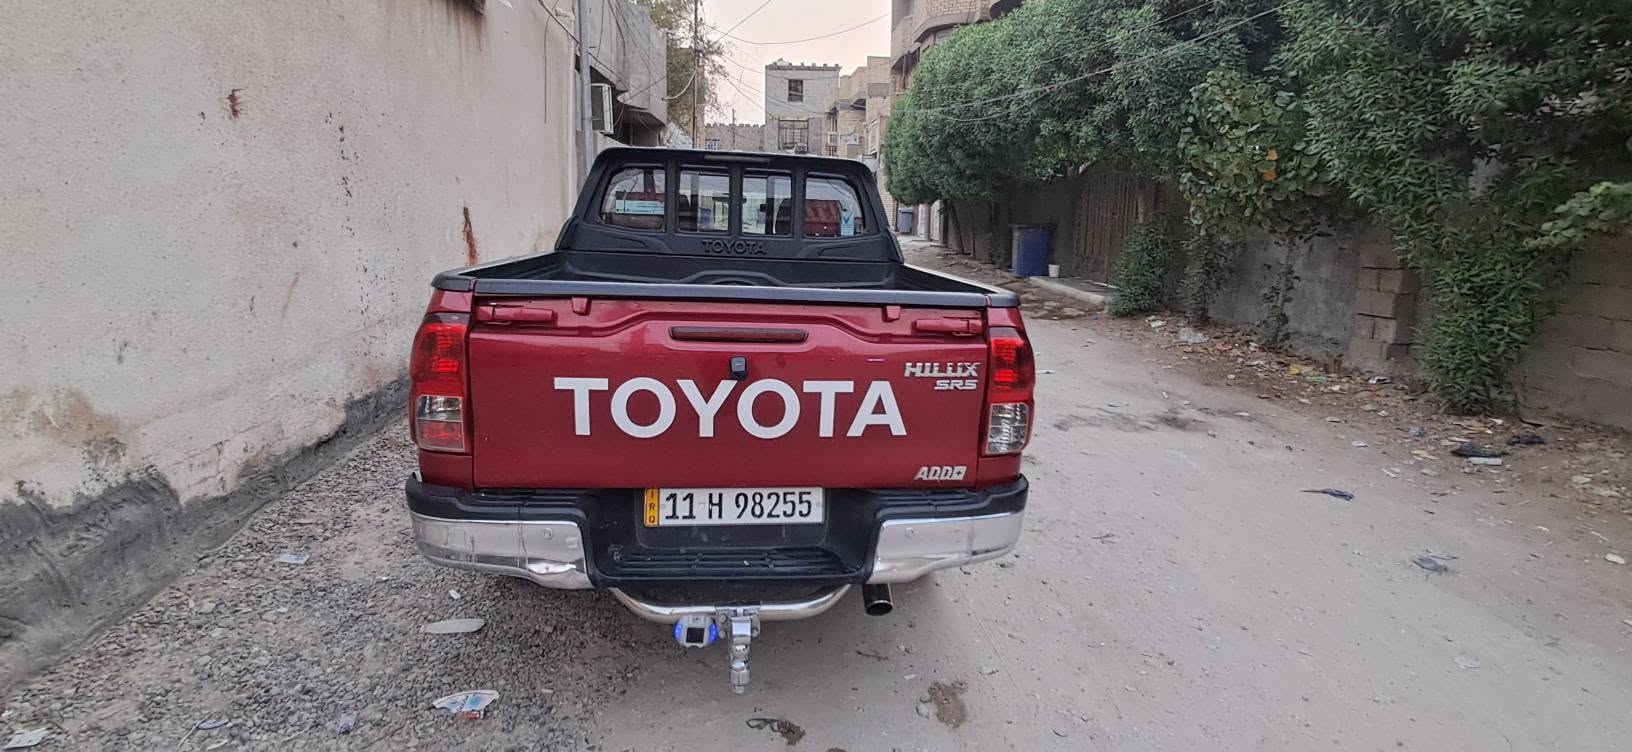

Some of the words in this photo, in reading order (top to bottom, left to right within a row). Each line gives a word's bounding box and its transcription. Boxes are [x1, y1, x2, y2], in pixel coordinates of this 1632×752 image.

[703, 240, 766, 256] TOYOTA
[904, 362, 980, 377] HILUX
[554, 377, 907, 438] TOYOTA
[665, 492, 696, 520] 11
[708, 492, 723, 520] H
[735, 492, 812, 518] 98255
